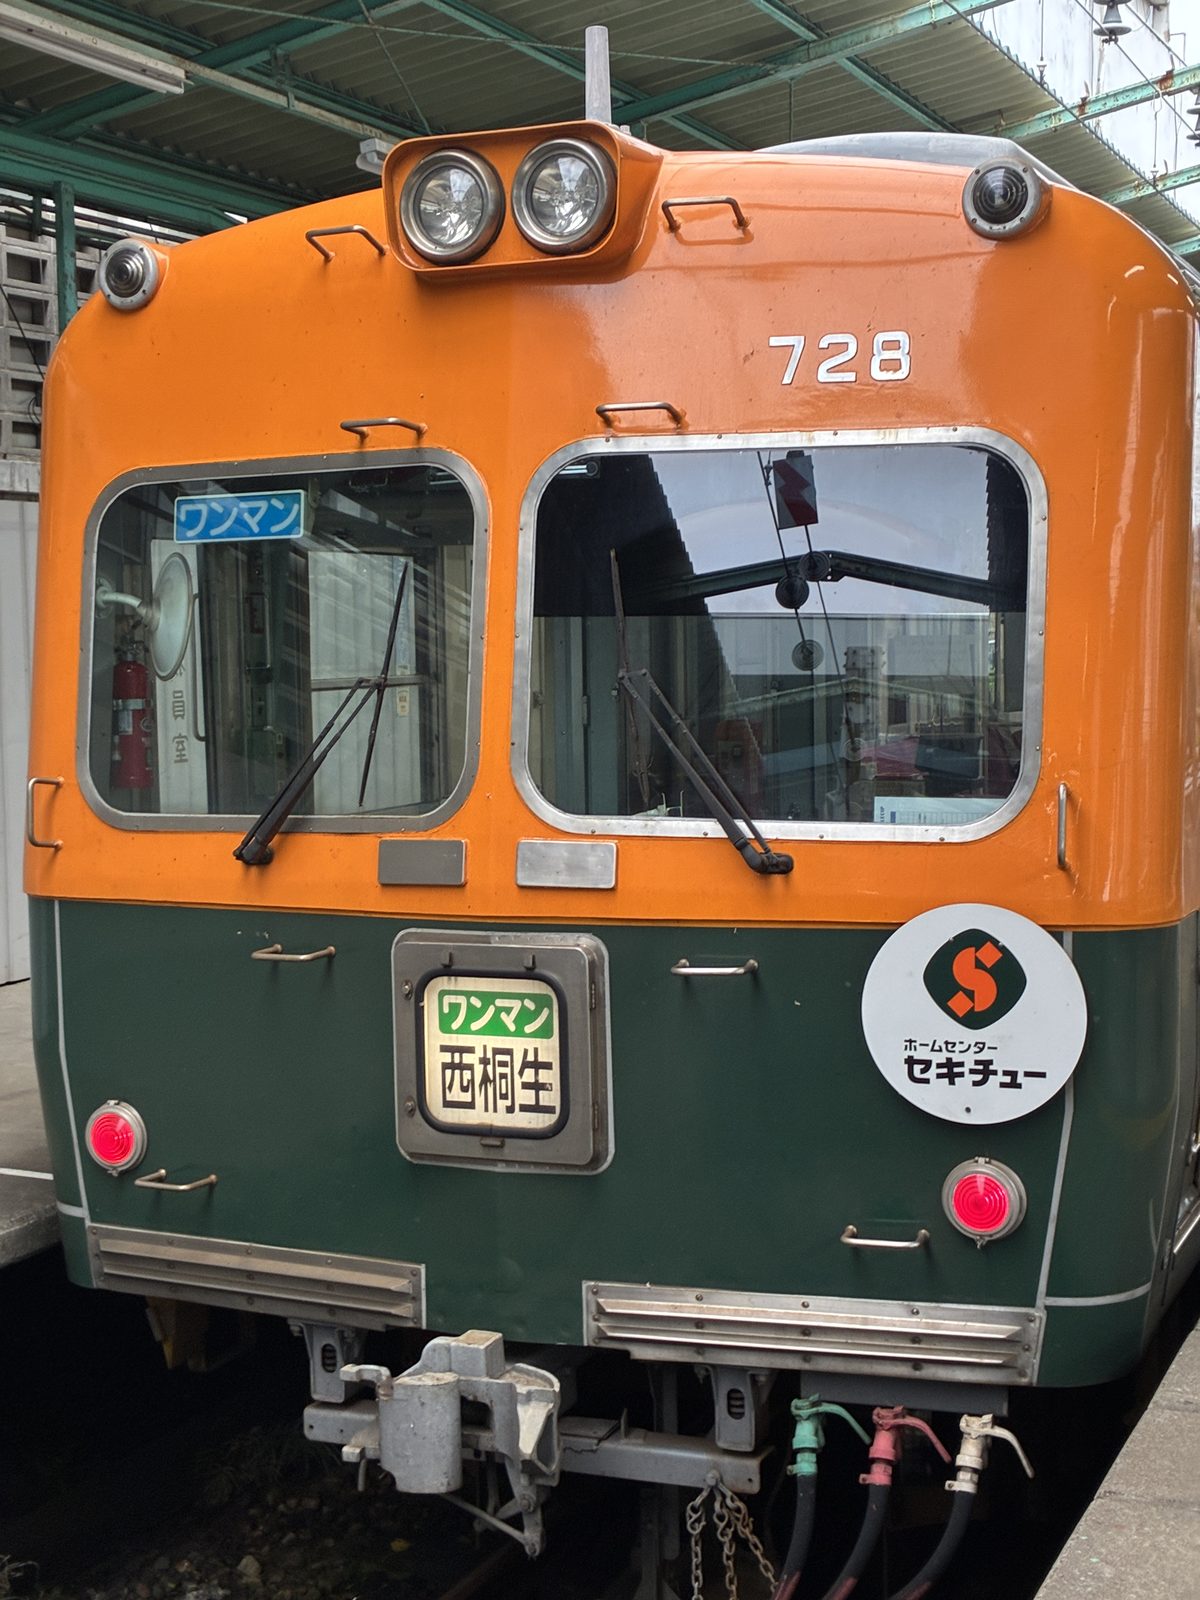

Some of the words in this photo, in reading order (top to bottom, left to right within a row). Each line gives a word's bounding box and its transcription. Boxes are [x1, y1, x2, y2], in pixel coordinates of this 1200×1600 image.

[768, 331, 911, 385] 728
[180, 497, 300, 537] ワンマン
[442, 994, 550, 1034] ワンマン
[903, 1038, 998, 1054] ホームセンター
[439, 1044, 557, 1115] 西桐生
[903, 1055, 1047, 1089] セキチュー
